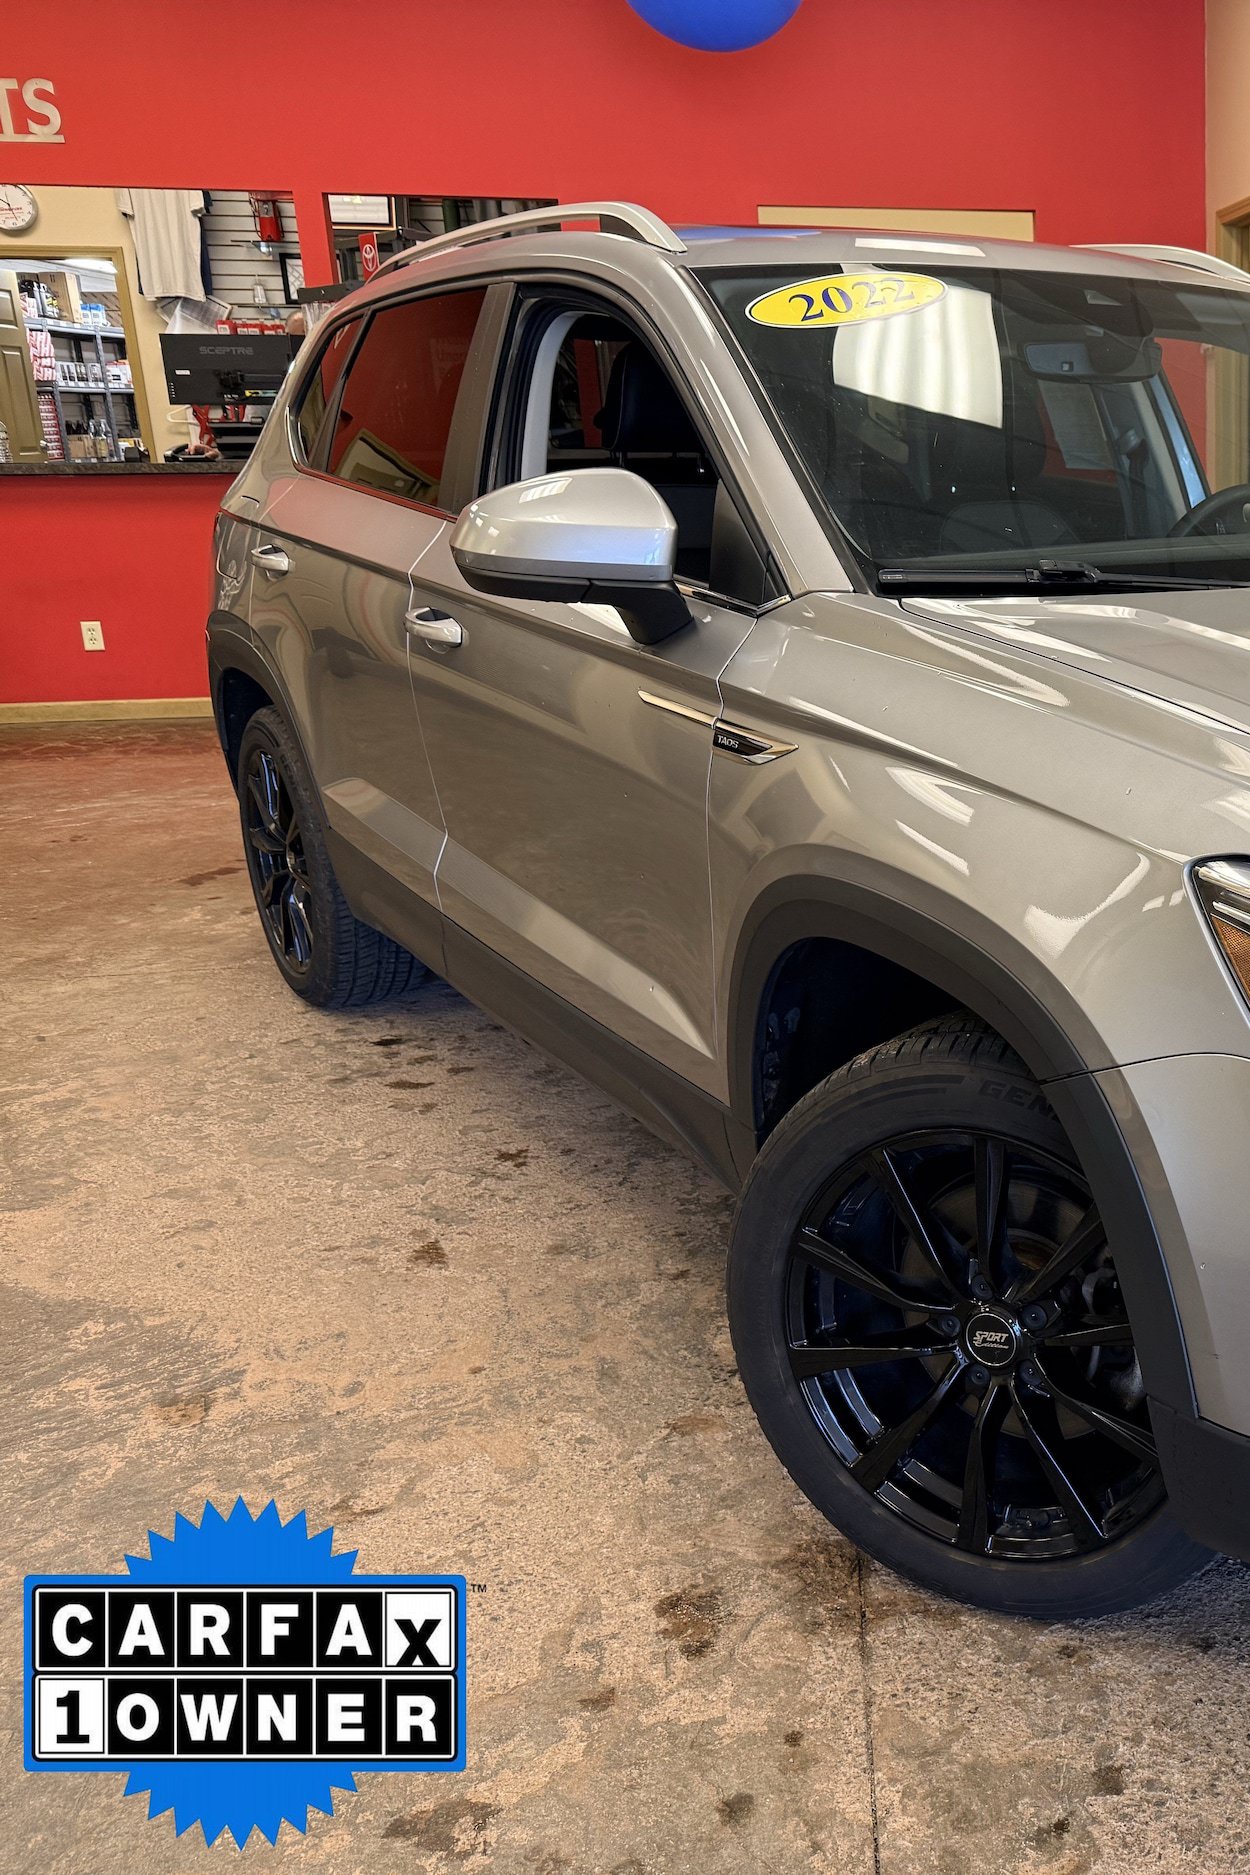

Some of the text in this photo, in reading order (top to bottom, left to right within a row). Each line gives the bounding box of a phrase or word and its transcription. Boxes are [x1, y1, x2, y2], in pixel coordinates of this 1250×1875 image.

[789, 278, 915, 322] 2022
[199, 346, 255, 355] SCEPTRE
[717, 734, 739, 749] TAOS
[973, 1330, 1009, 1343] SPORT
